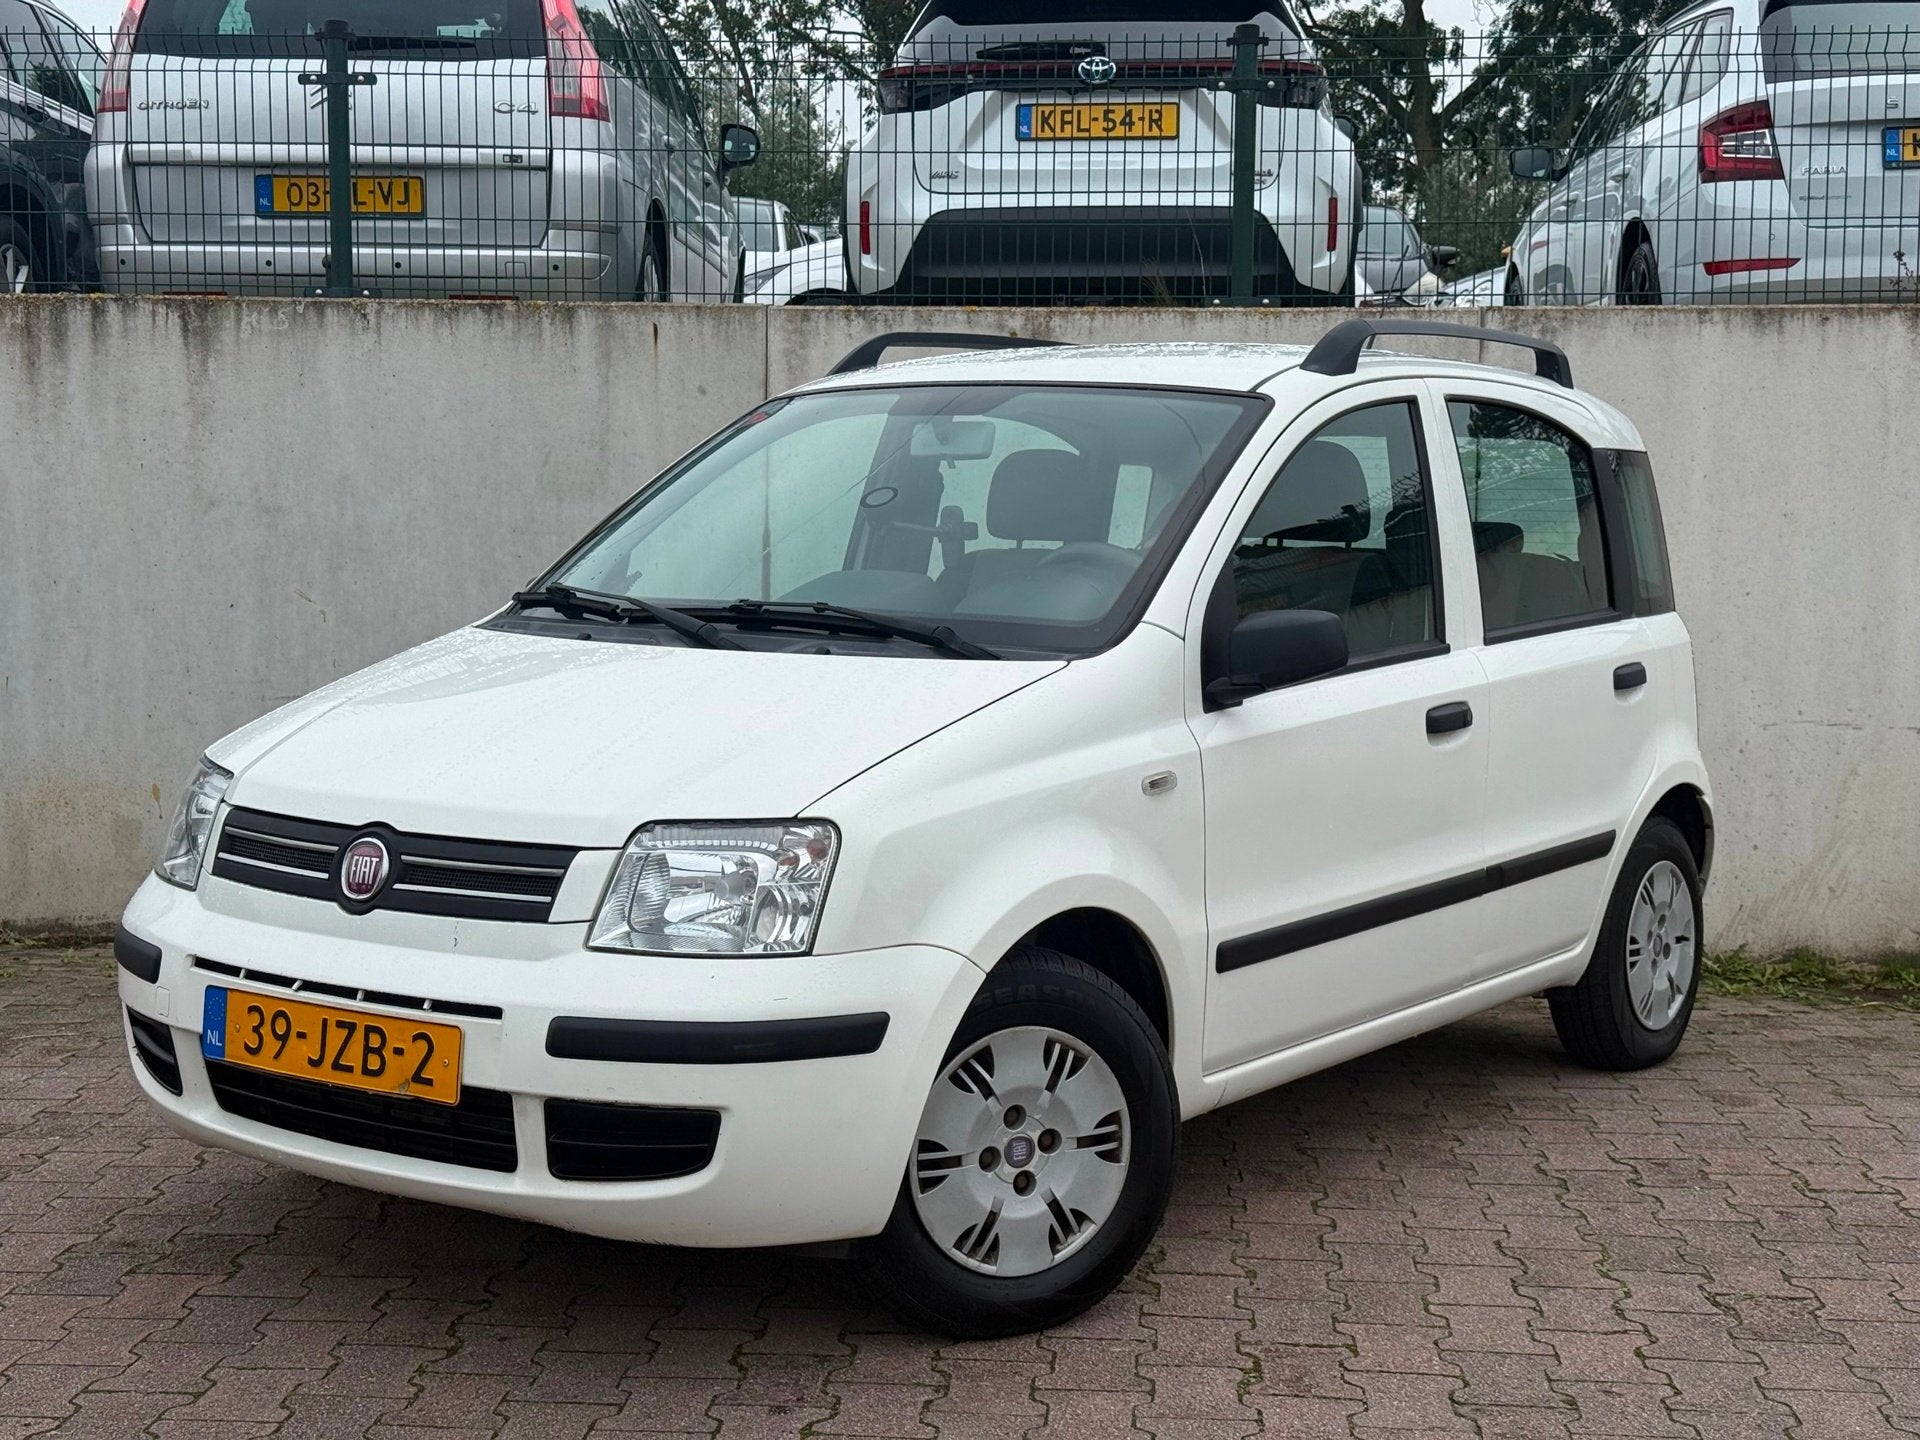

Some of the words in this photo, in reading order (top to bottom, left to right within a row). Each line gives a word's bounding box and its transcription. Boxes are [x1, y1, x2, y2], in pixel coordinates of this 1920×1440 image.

[137, 98, 210, 110] CITROËN
[494, 100, 539, 115] C4
[1040, 109, 1163, 133] KFL-54-R
[1801, 166, 1847, 176] FABIA
[259, 198, 271, 206] NL
[286, 181, 410, 207] 03-L-VJ
[350, 856, 380, 884] FIAT
[207, 1029, 222, 1047] NL
[243, 1003, 435, 1087] 39-JZB-2
[1013, 1141, 1027, 1160] FIAT
